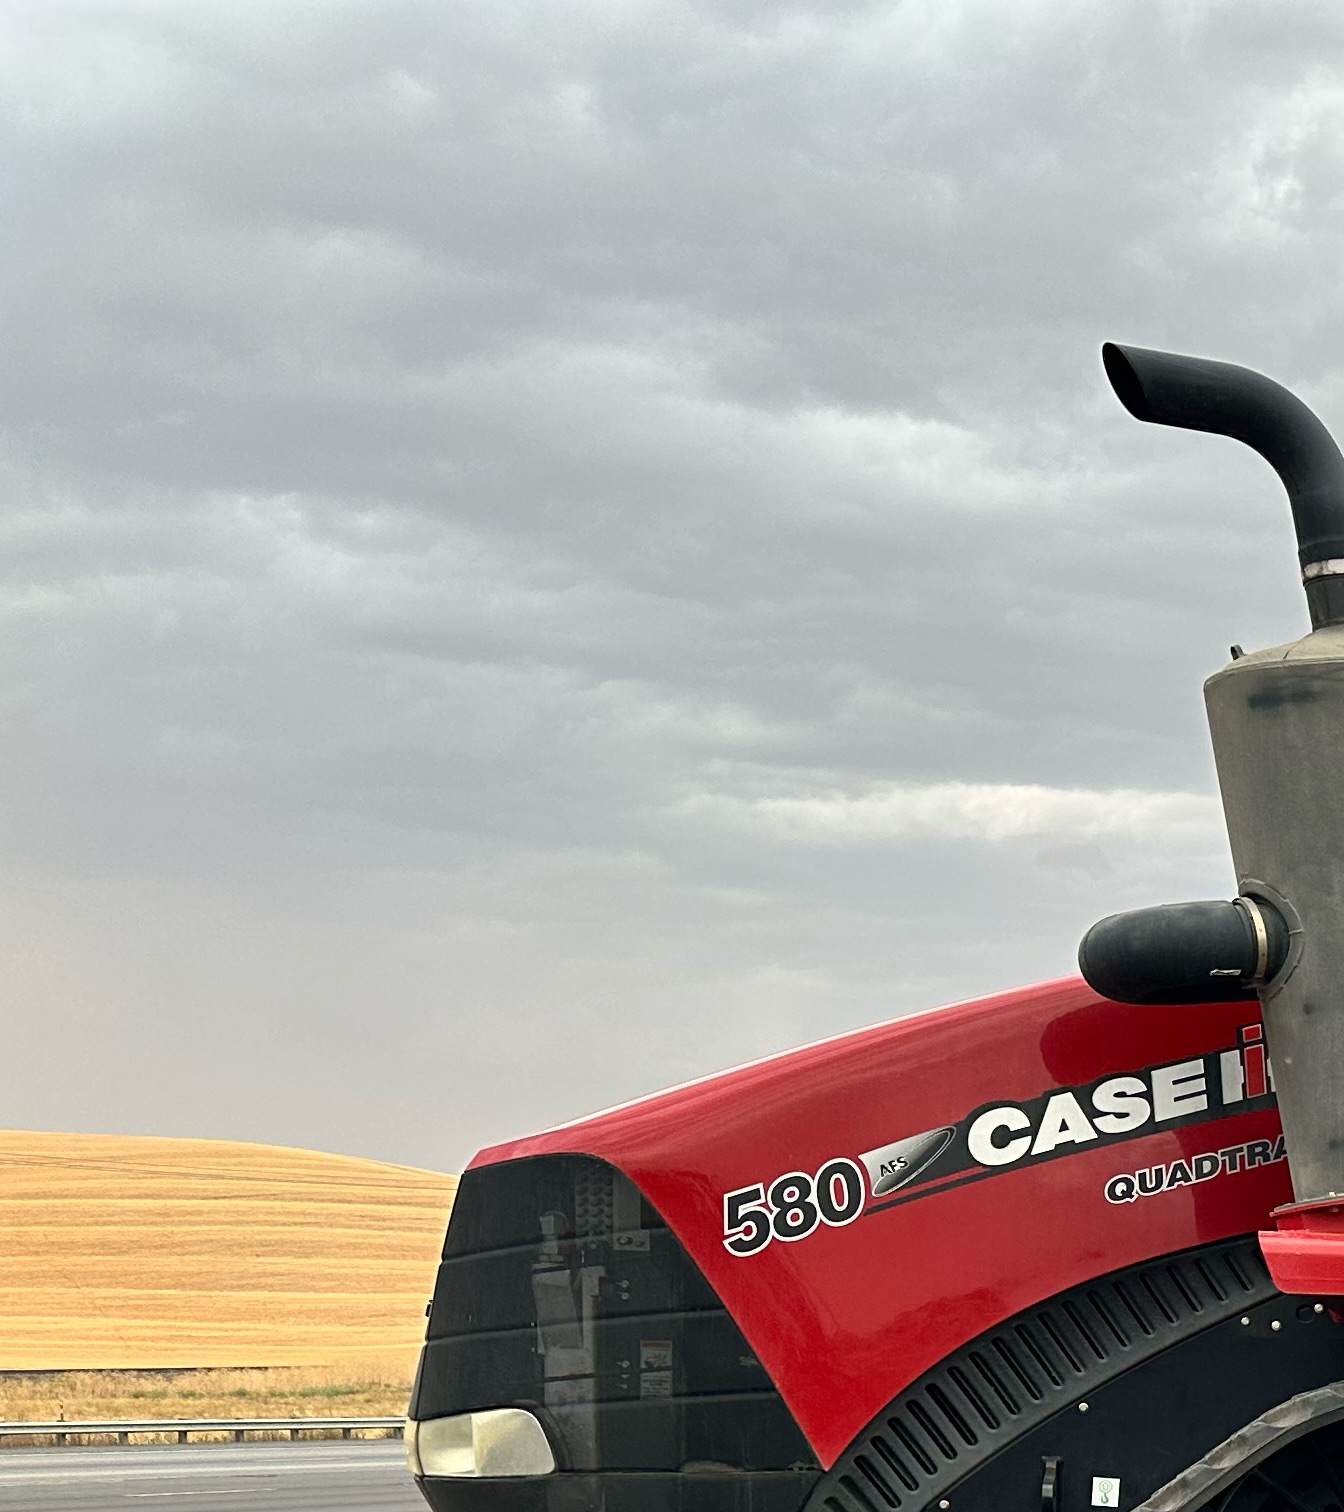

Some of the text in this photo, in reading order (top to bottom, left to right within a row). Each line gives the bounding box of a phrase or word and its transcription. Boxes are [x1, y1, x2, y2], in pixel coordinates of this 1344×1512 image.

[967, 1058, 1208, 1166] CASE
[722, 1157, 866, 1257] 580
[879, 1156, 909, 1177] AFS
[1104, 1133, 1290, 1205] QUADTRA
